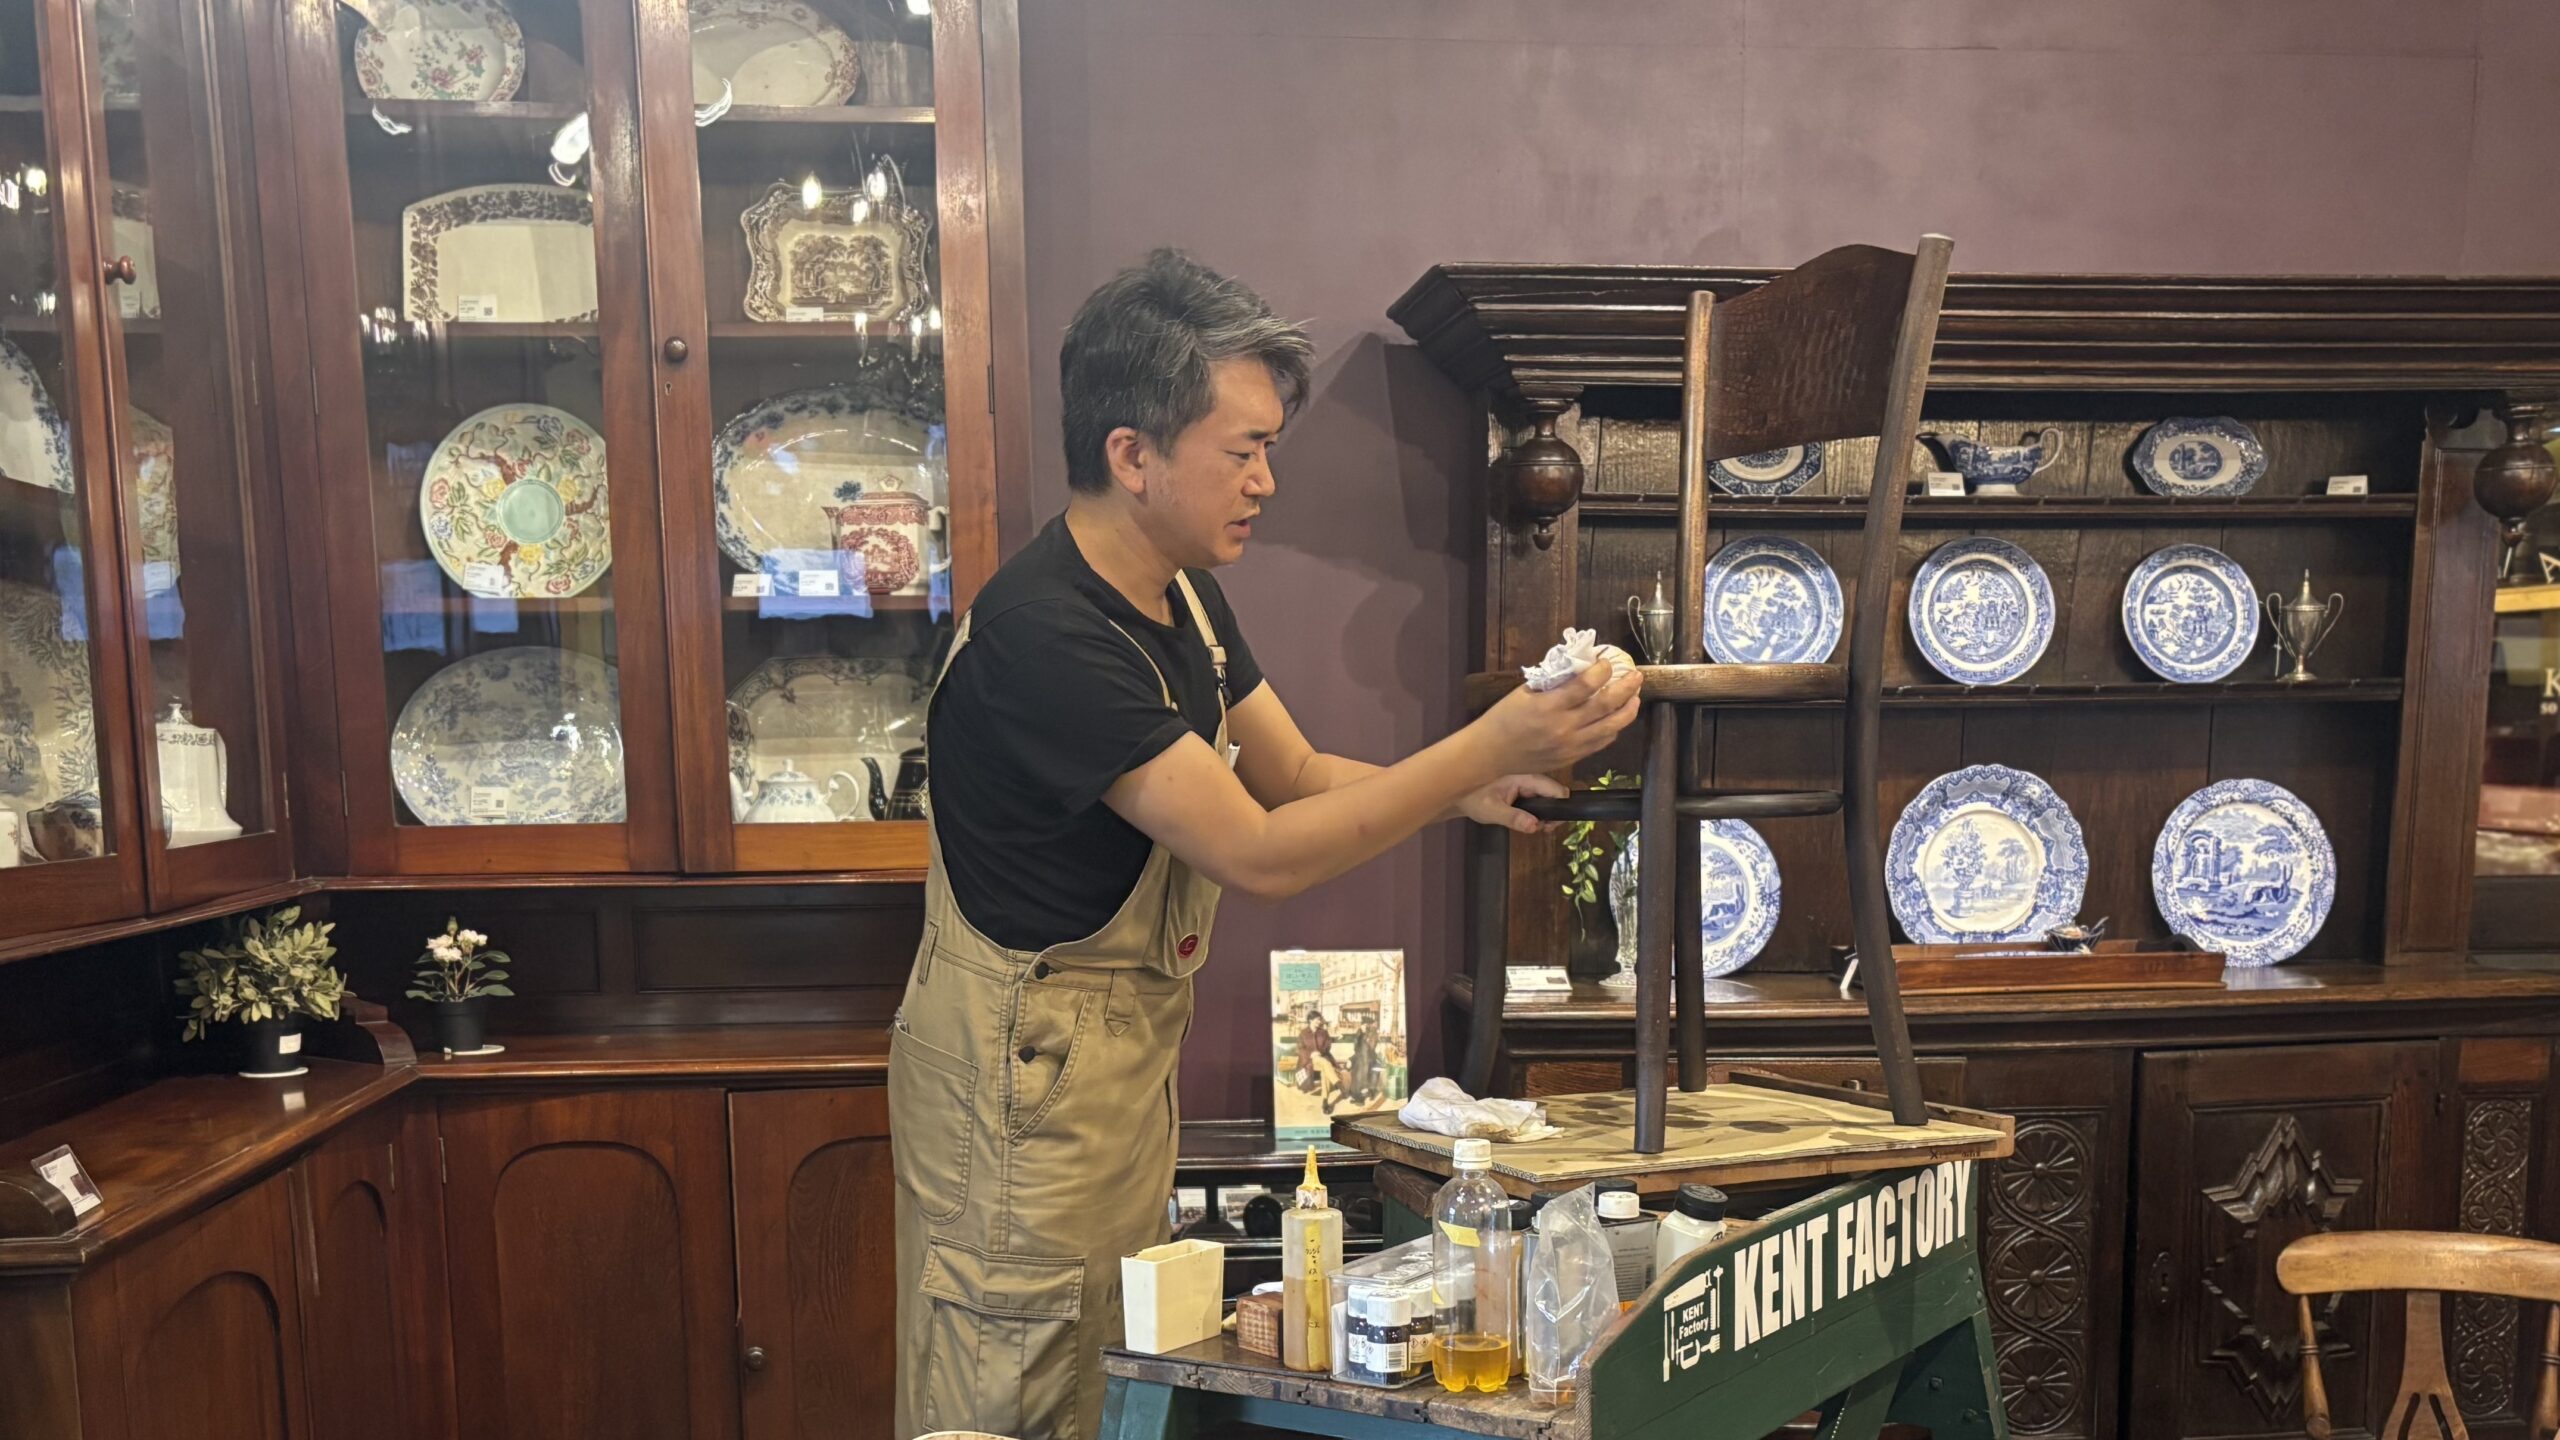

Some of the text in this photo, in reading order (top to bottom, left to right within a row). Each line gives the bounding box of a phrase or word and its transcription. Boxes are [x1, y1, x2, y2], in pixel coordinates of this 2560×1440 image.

[1734, 1159, 1971, 1352] KENT FACTORY
[1682, 1301, 1705, 1324] KENT
[1678, 1317, 1709, 1340] Factory
